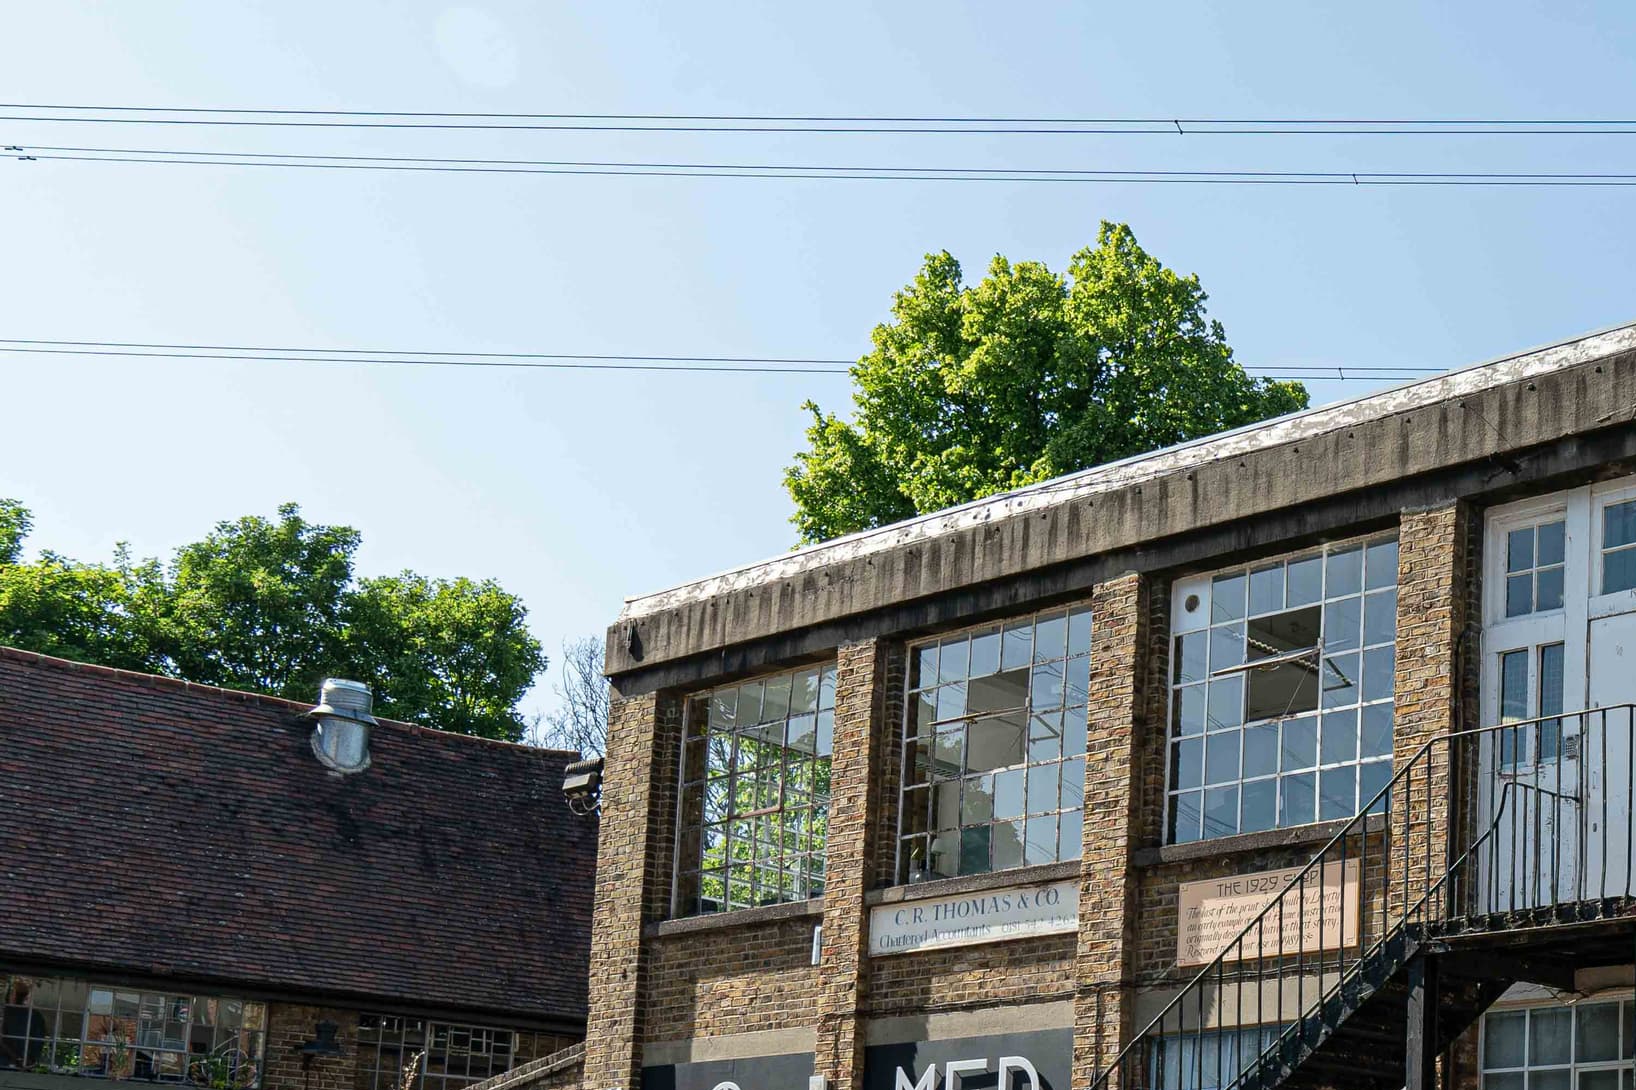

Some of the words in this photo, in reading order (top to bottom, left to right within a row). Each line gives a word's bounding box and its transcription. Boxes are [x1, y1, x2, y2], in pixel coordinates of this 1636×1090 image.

[1217, 881, 1241, 897] THE
[1246, 875, 1279, 893] 1929
[1283, 870, 1319, 889] SOP
[895, 911, 908, 926] C.
[913, 907, 928, 924] R.
[933, 893, 1011, 921] THOMAS
[1018, 896, 1029, 909] &
[1034, 887, 1060, 908] CO.
[1226, 902, 1239, 915] the
[1239, 900, 1259, 916] print
[1311, 890, 1341, 906] Lierty
[879, 929, 928, 948] Chartered
[933, 923, 991, 941] Accountants
[1289, 918, 1312, 931] thrd
